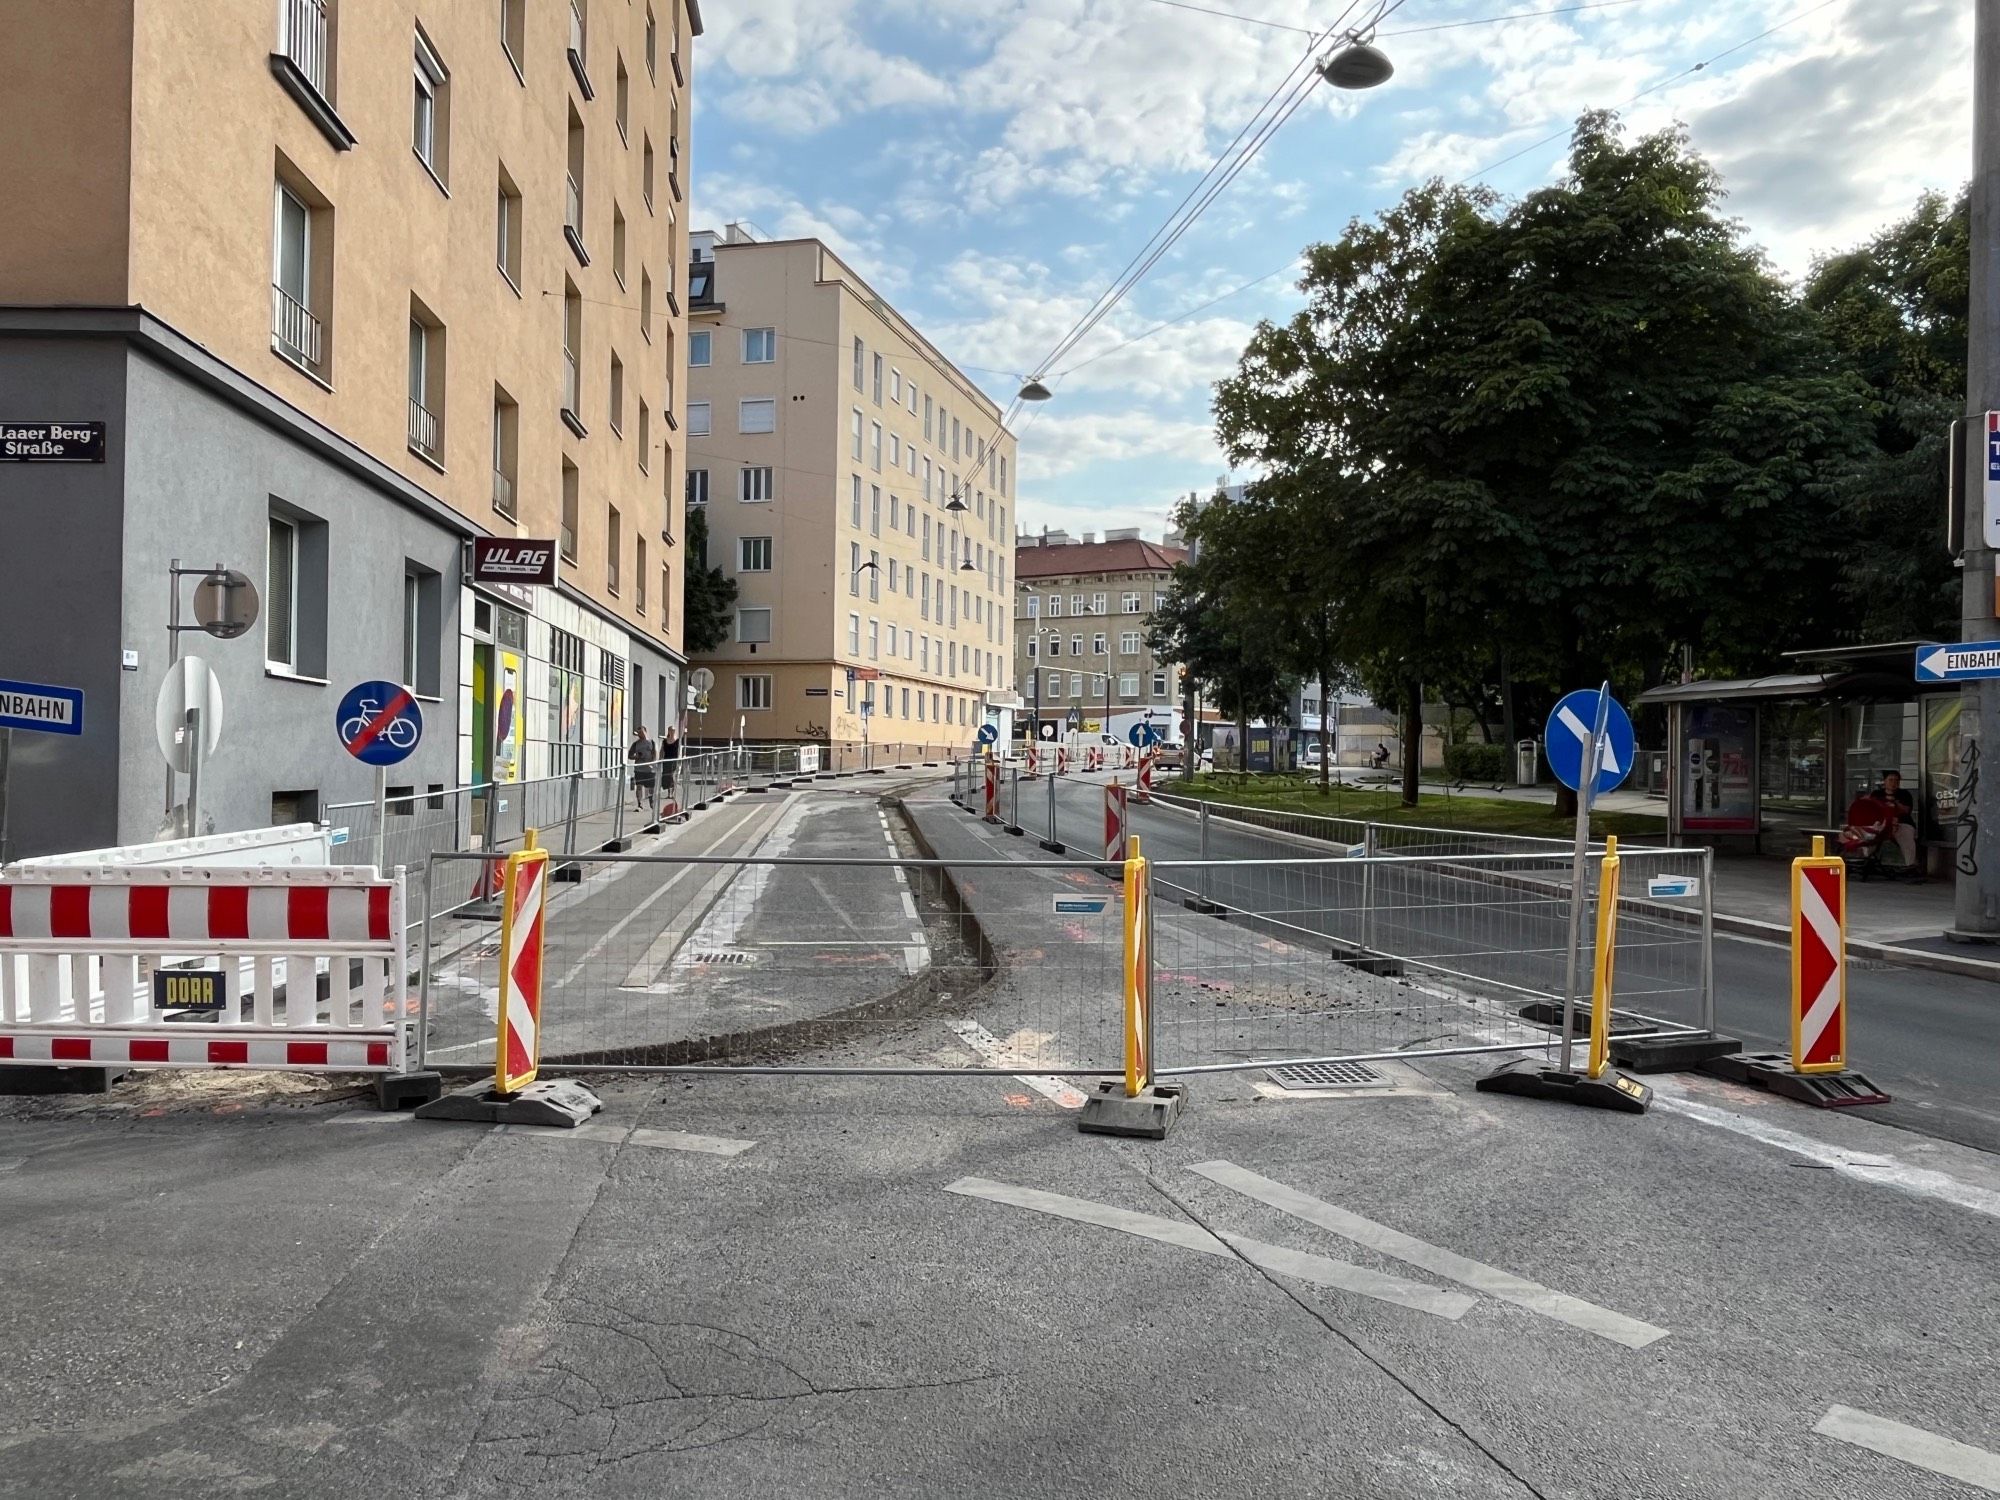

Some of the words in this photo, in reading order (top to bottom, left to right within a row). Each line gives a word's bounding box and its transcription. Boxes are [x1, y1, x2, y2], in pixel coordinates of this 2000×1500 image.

[0, 426, 46, 440] Laaer
[50, 425, 98, 443] Berg-
[5, 441, 64, 455] Straße
[485, 548, 549, 565] ULAG
